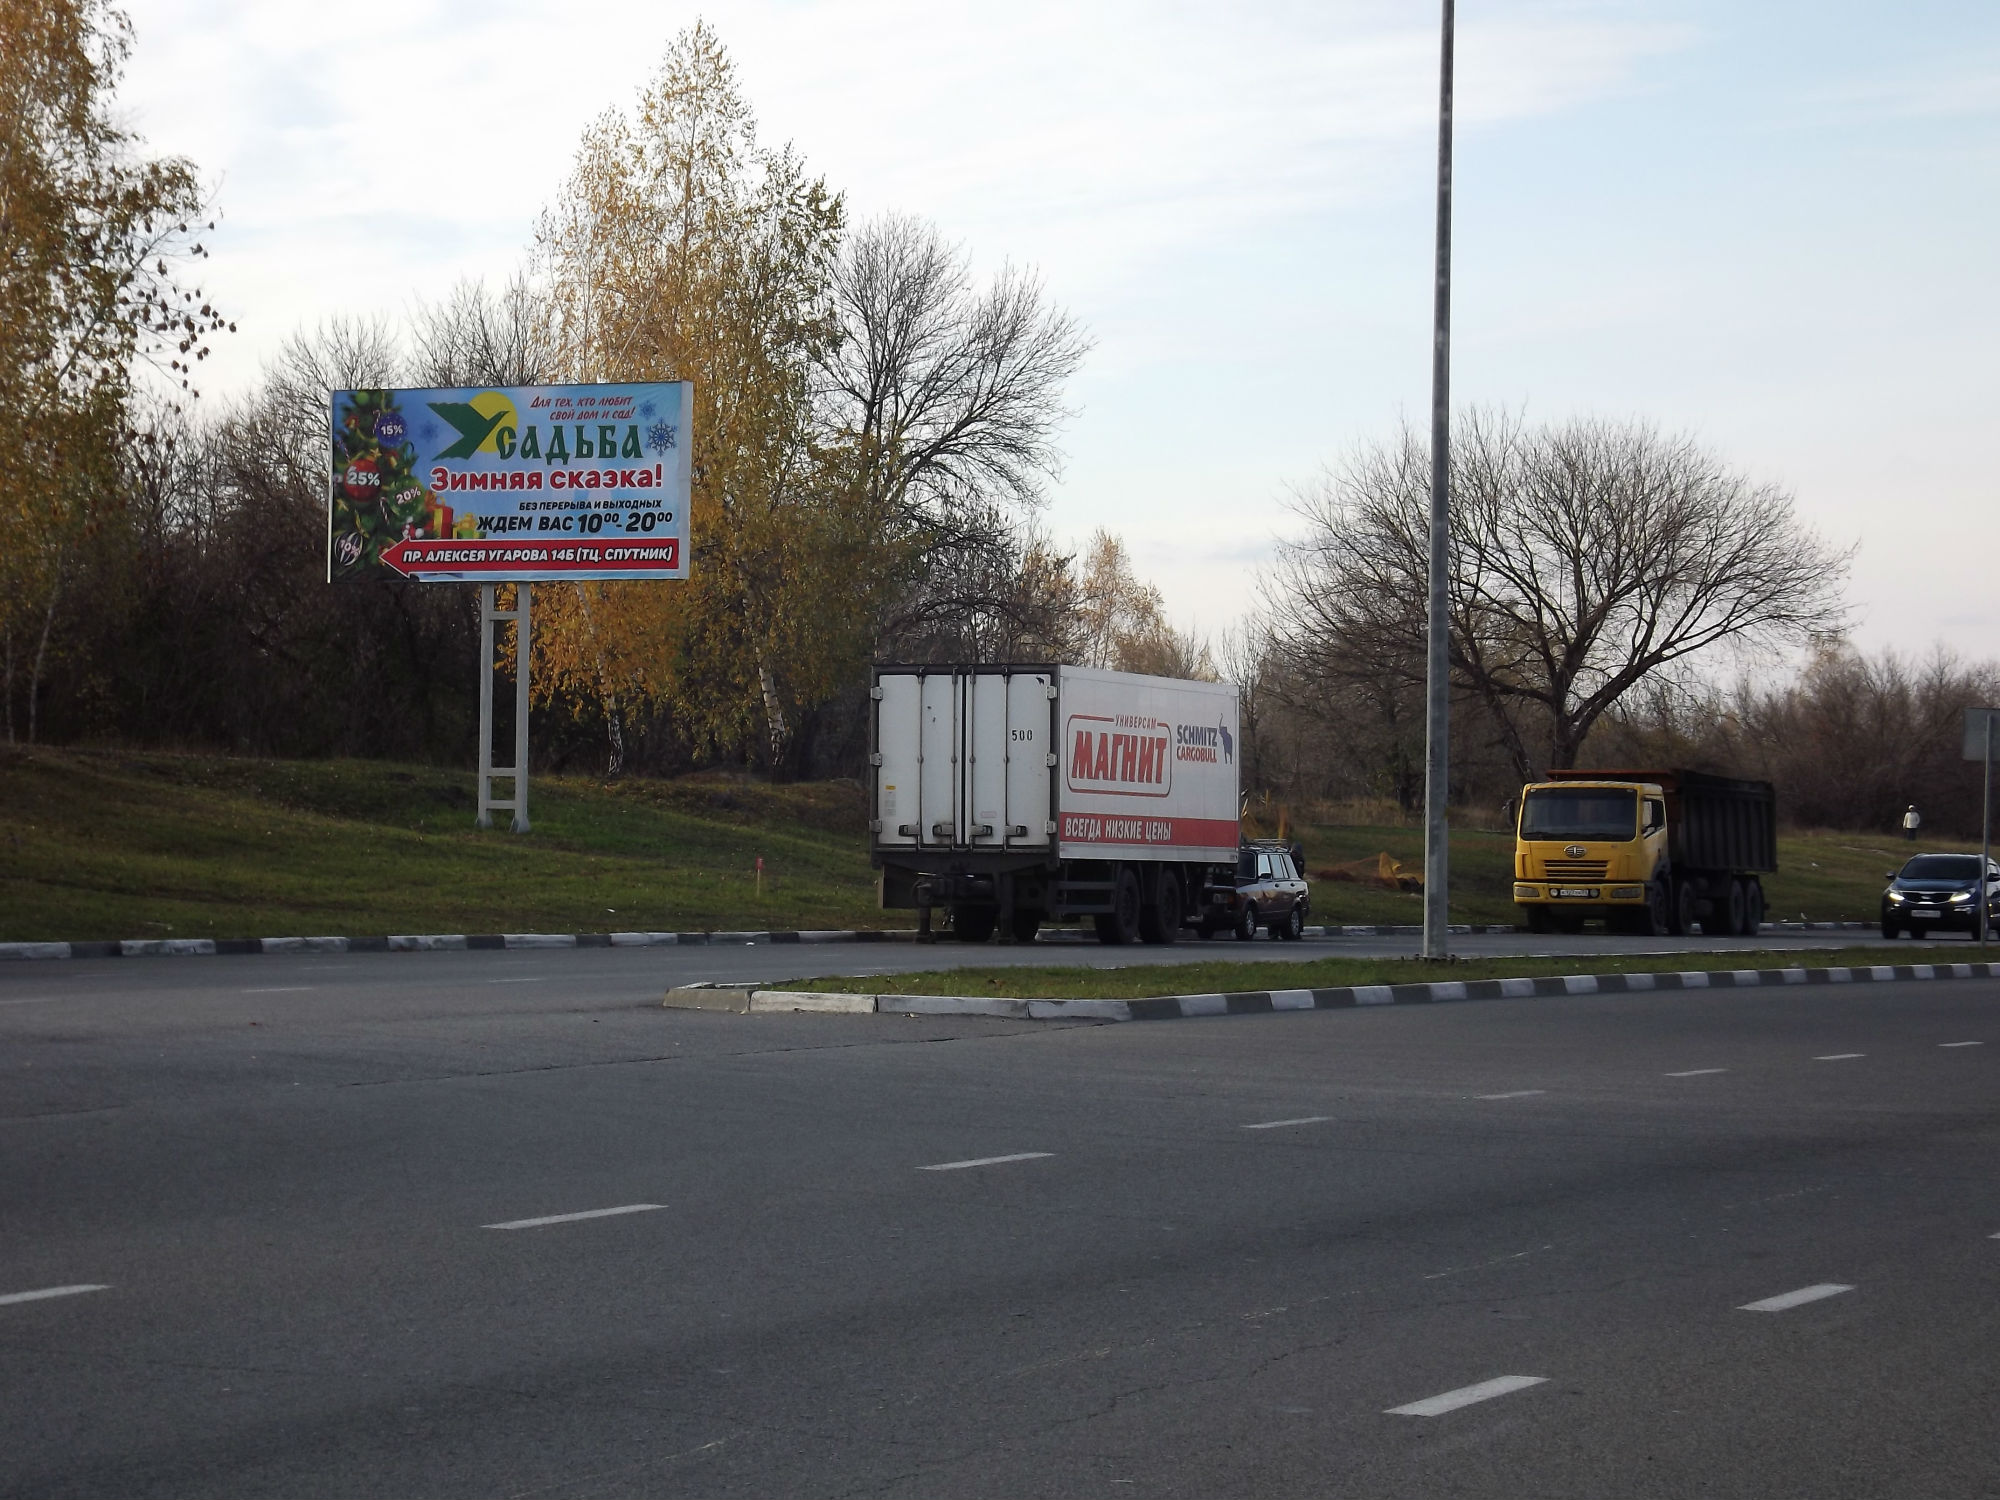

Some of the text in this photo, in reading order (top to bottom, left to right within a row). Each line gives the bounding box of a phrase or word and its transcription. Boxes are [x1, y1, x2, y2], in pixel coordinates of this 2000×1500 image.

[380, 425, 403, 435] 15%
[347, 472, 380, 486] 25%
[430, 463, 663, 491] Зимняя сказка!
[396, 487, 421, 505] 20%
[519, 499, 662, 511] БЕЗ ПЕРЕРЫВА И ВЫХОДНЫХ
[477, 516, 532, 533] ЖДЕМ
[538, 516, 573, 531] ВАС
[402, 550, 424, 562] ПР.
[425, 550, 487, 562] АЛЕКСЕЯ
[488, 549, 549, 561] УГАРОВА
[604, 546, 673, 562] СПУТНИК)
[1115, 714, 1157, 730] УНИВЕРСАМ
[1011, 729, 1033, 741] 500
[1176, 724, 1218, 747] SCHMITZ
[1071, 730, 1167, 784] МАГНИТ
[1176, 747, 1217, 763] CARGOBULL
[1065, 818, 1172, 842] ВСЕГДА НИЗКИЕ ЦЕНЫ
